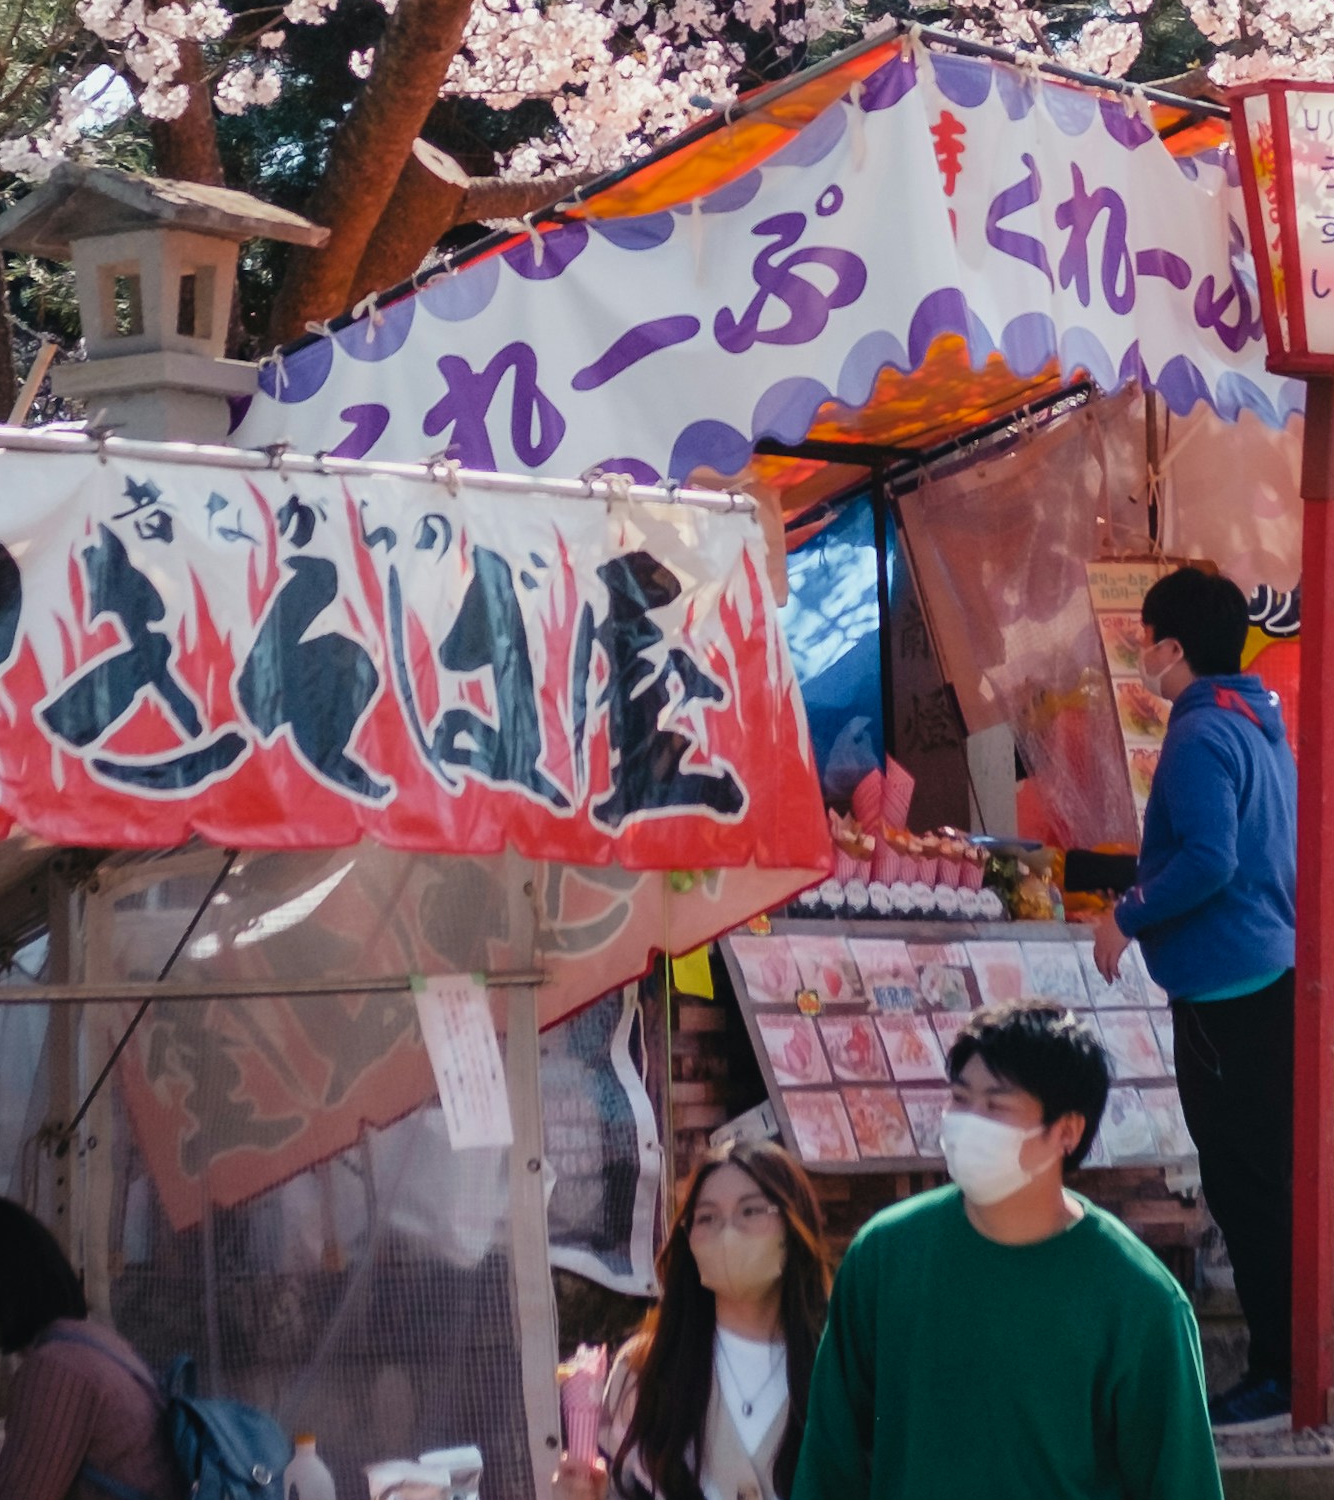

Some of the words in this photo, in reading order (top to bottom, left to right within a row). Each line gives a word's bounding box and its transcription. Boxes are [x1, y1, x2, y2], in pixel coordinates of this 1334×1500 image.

[111, 474, 454, 565] 昔ながらの
